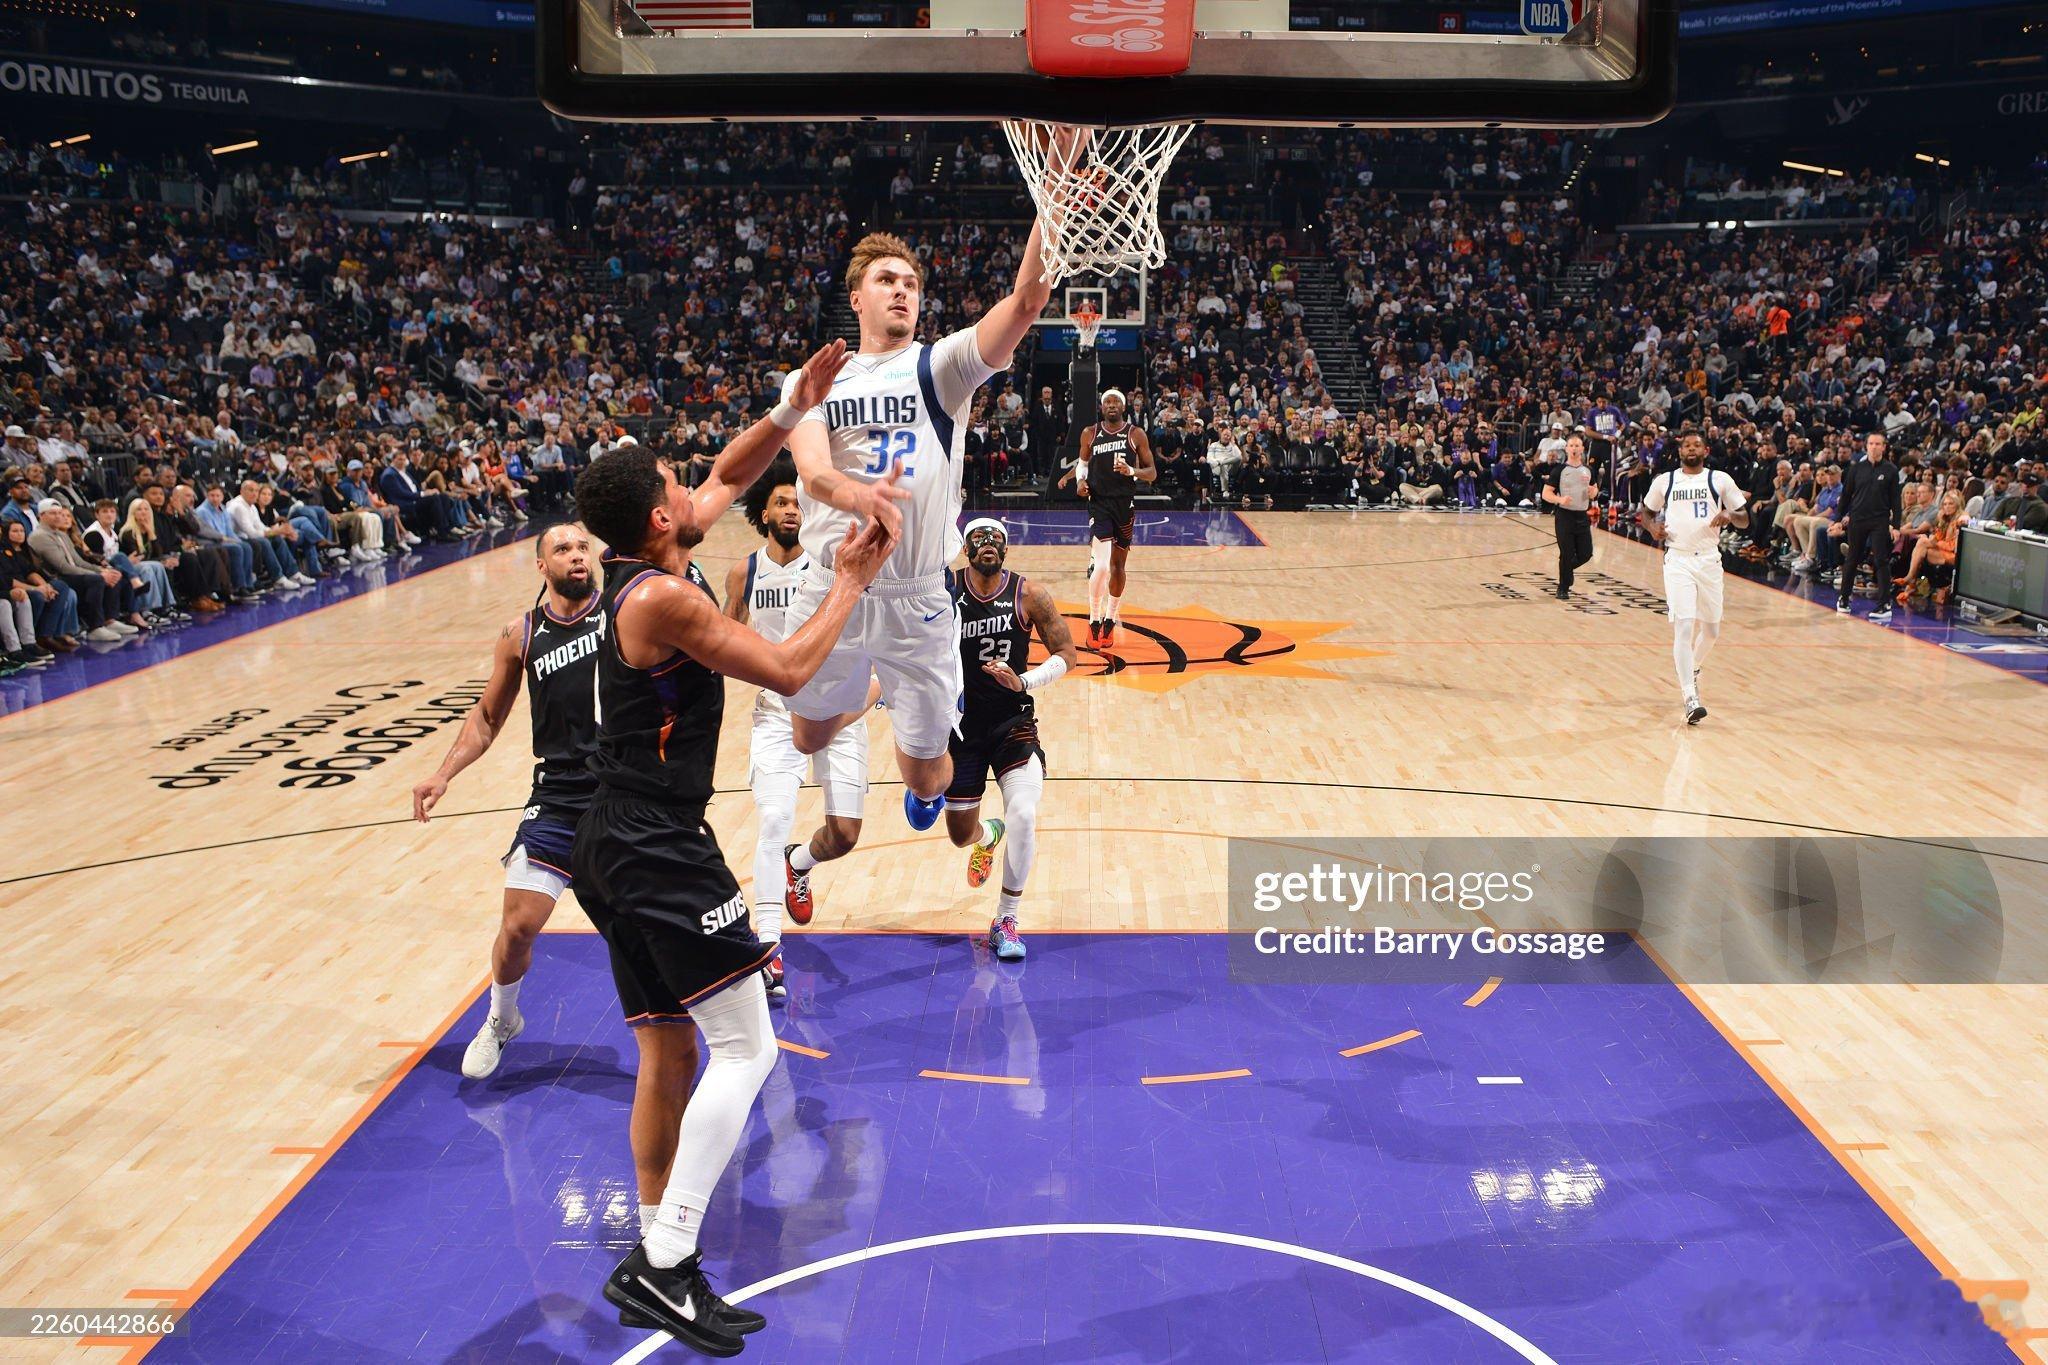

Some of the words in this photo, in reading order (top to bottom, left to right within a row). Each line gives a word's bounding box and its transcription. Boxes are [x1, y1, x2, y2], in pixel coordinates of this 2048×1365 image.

[1443, 17, 1456, 28] 20
[1471, 19, 1503, 29] Phoenix
[1530, 3, 1560, 27] NBA
[1713, 15, 1741, 26] Official
[1769, 9, 1788, 19] Care
[1789, 7, 1819, 17] Partner
[1830, 4, 1844, 13] the
[1845, 1, 1879, 11] Phoenix
[169, 82, 249, 104] TEQUILA
[884, 370, 914, 380] chime
[826, 395, 916, 431] DALLAS
[866, 429, 916, 477] 32
[1093, 440, 1127, 456] PHOENIX
[1672, 488, 1708, 501] DALLAS
[1692, 501, 1708, 519] 13
[755, 587, 796, 609] DALL
[533, 629, 602, 682] PHOENI
[979, 638, 1012, 662] 23
[150, 707, 270, 752] center
[149, 704, 372, 789] matchup
